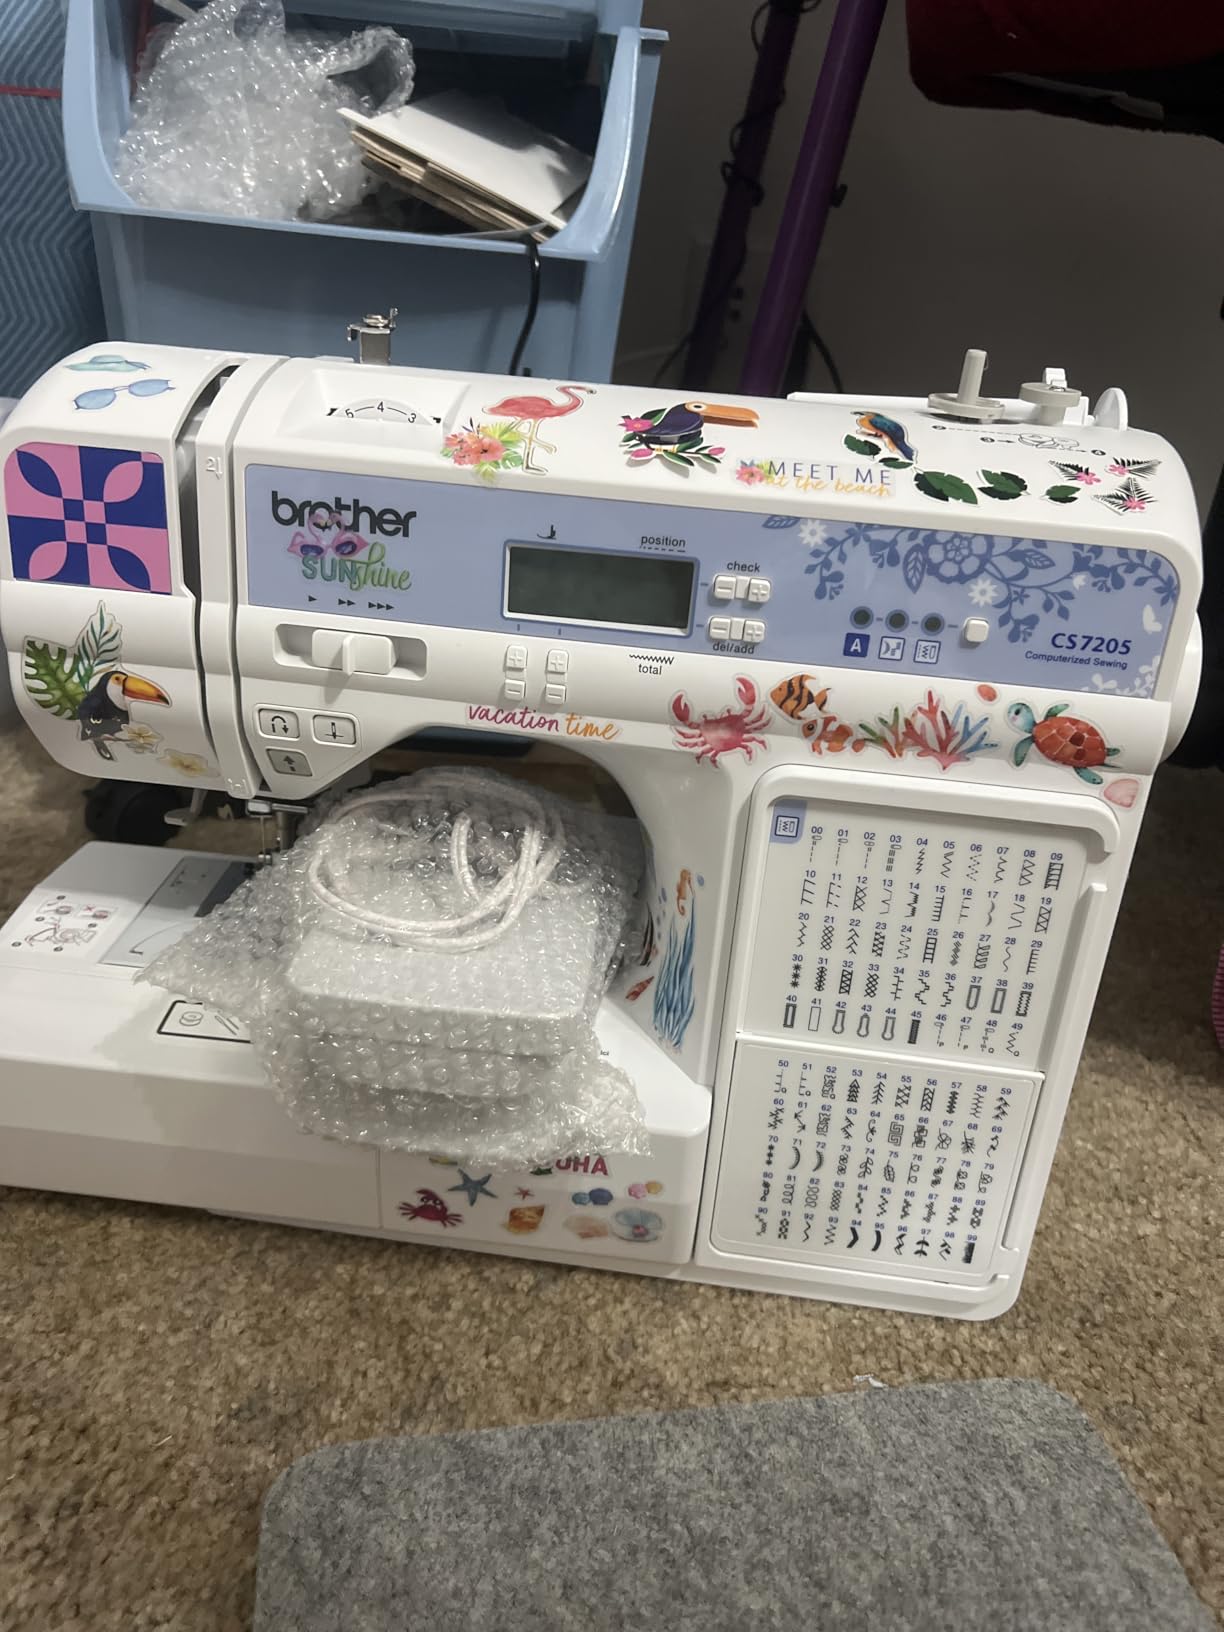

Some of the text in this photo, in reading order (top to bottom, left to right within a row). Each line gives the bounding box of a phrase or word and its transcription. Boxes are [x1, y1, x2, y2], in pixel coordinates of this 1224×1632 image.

[377, 401, 384, 412] 4
[408, 413, 416, 423] 3
[768, 460, 891, 485] MEET ME
[796, 476, 827, 491] the
[835, 479, 890, 496] beach
[272, 490, 416, 537] brother
[640, 535, 686, 547] position
[727, 561, 761, 572] check
[713, 642, 755, 654] del/add
[850, 638, 861, 653] A
[1051, 633, 1132, 655] CS7205
[638, 664, 662, 675] total
[1025, 651, 1128, 670] Computerized Sewing
[469, 706, 619, 740] vacation time
[811, 826, 823, 834] 00
[838, 829, 848, 837] 01
[864, 832, 876, 840] 02
[943, 841, 955, 849] 05
[806, 870, 816, 878] 10
[857, 876, 868, 884] 12
[962, 888, 972, 896] 16
[875, 922, 886, 930] 23
[901, 925, 912, 933] 24
[1005, 937, 1016, 945] 28
[1031, 940, 1042, 948] 29
[792, 954, 803, 962] 30
[842, 960, 853, 968] 32
[868, 964, 880, 972] 33
[893, 967, 905, 975] 34
[944, 973, 956, 981] 36
[996, 979, 1008, 987] 38
[1022, 982, 1034, 990] 39
[786, 995, 797, 1003] 40
[935, 1014, 947, 1022] 46
[986, 1020, 998, 1028] 48
[1012, 1023, 1023, 1031] 49
